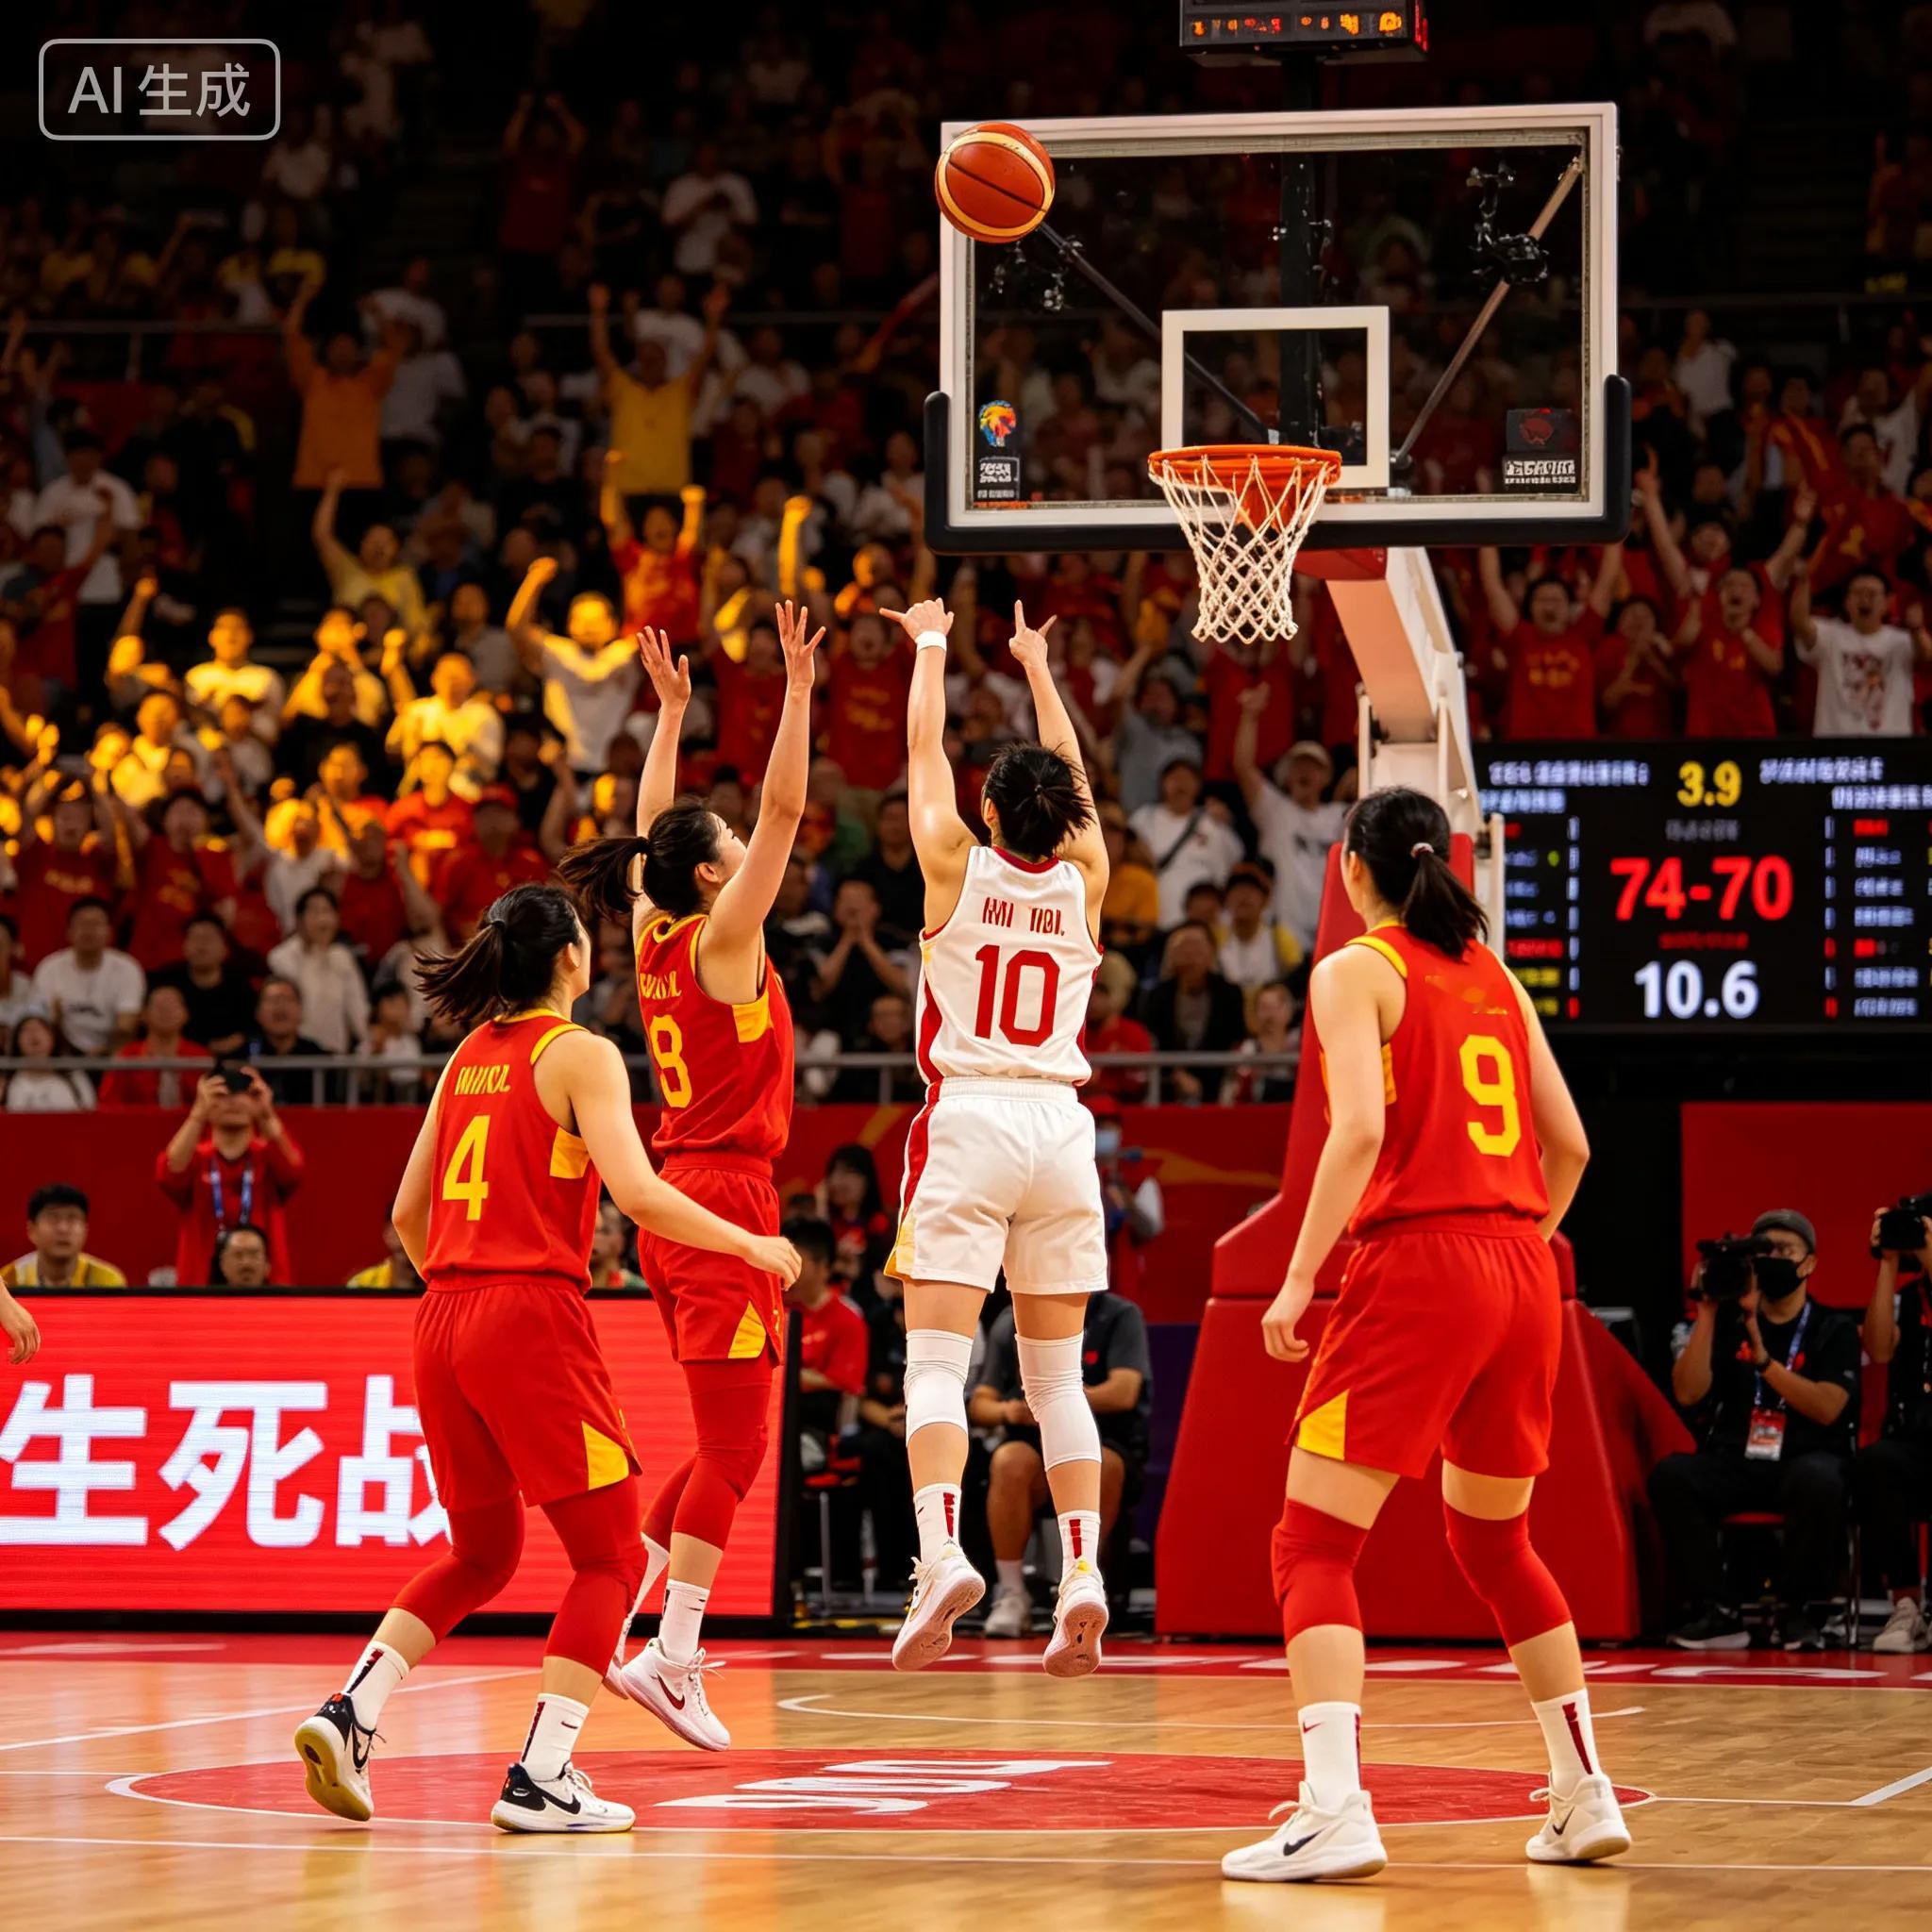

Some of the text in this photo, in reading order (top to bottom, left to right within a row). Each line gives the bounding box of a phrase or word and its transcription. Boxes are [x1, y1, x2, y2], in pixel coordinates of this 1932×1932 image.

[1676, 760, 1743, 808] 3.9
[1609, 855, 1794, 922] 74-70
[975, 944, 1060, 1047] 10
[1634, 959, 1760, 1019] 10.6
[649, 1015, 693, 1108] 8
[1459, 1034, 1522, 1158] 9
[442, 1114, 491, 1222] 4
